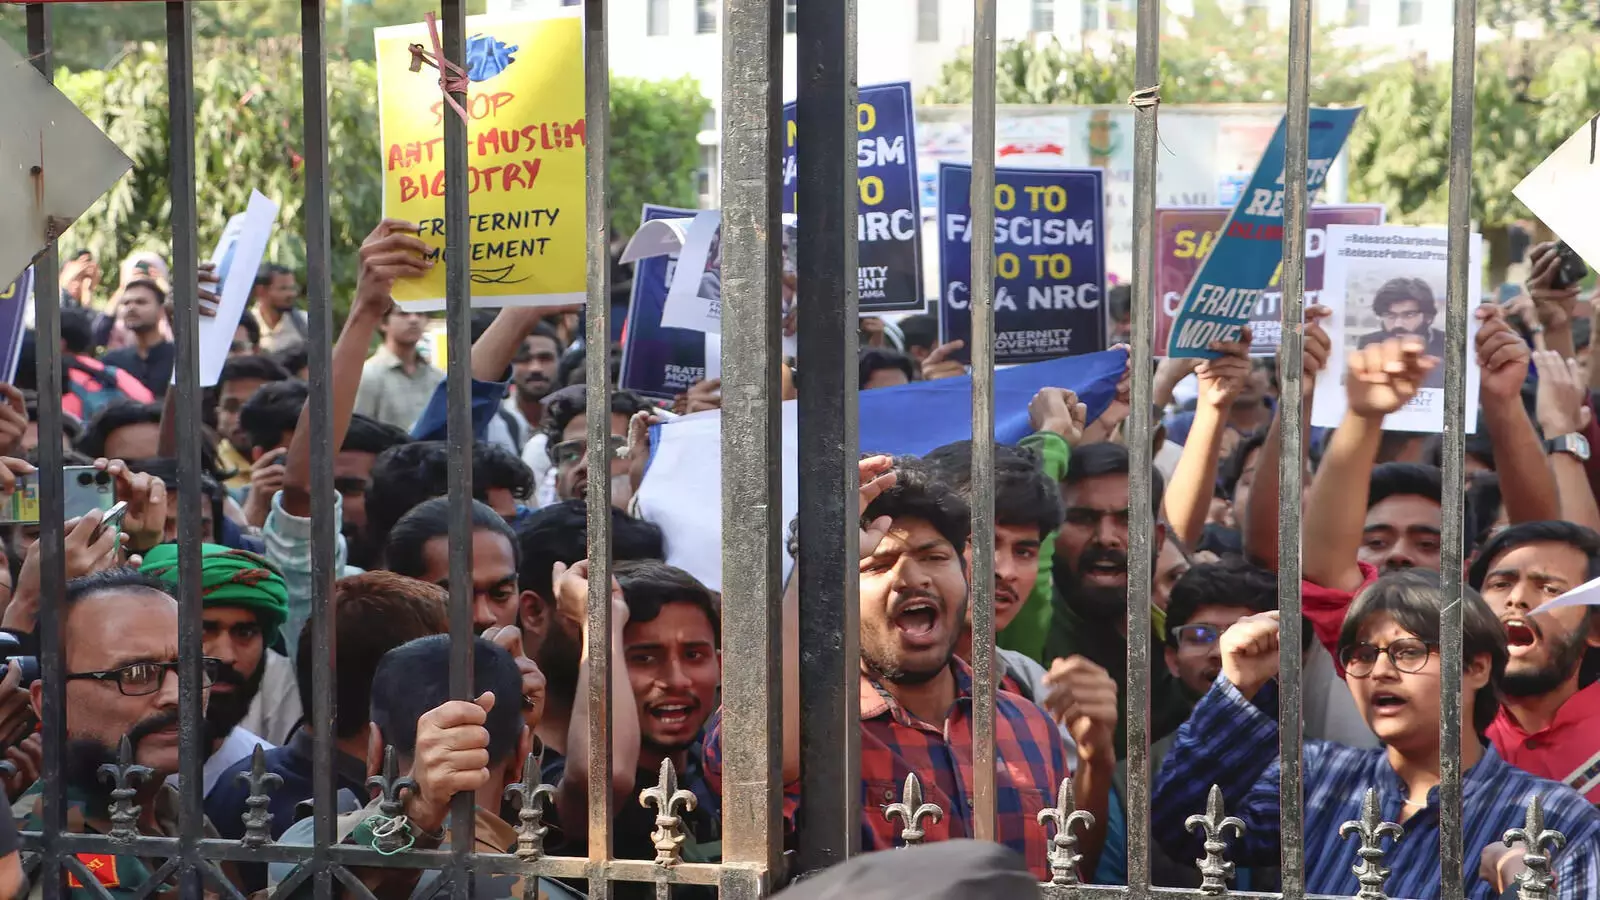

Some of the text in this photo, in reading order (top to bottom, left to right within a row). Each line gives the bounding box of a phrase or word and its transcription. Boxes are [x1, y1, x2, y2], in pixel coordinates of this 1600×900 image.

[430, 92, 515, 126] SOP
[389, 119, 585, 171] ANT-MUSLIM
[857, 176, 884, 206] O
[1024, 185, 1067, 213] TO
[417, 208, 560, 237] FRTERNITY
[423, 238, 551, 264] MEMENT
[993, 252, 1072, 279] O TO
[947, 281, 1100, 311] CA NRC
[1190, 283, 1262, 319] FRATE
[995, 329, 1072, 340] ATERNITY
[995, 337, 1070, 349] OVEMENT
[665, 364, 704, 376] FRATE
